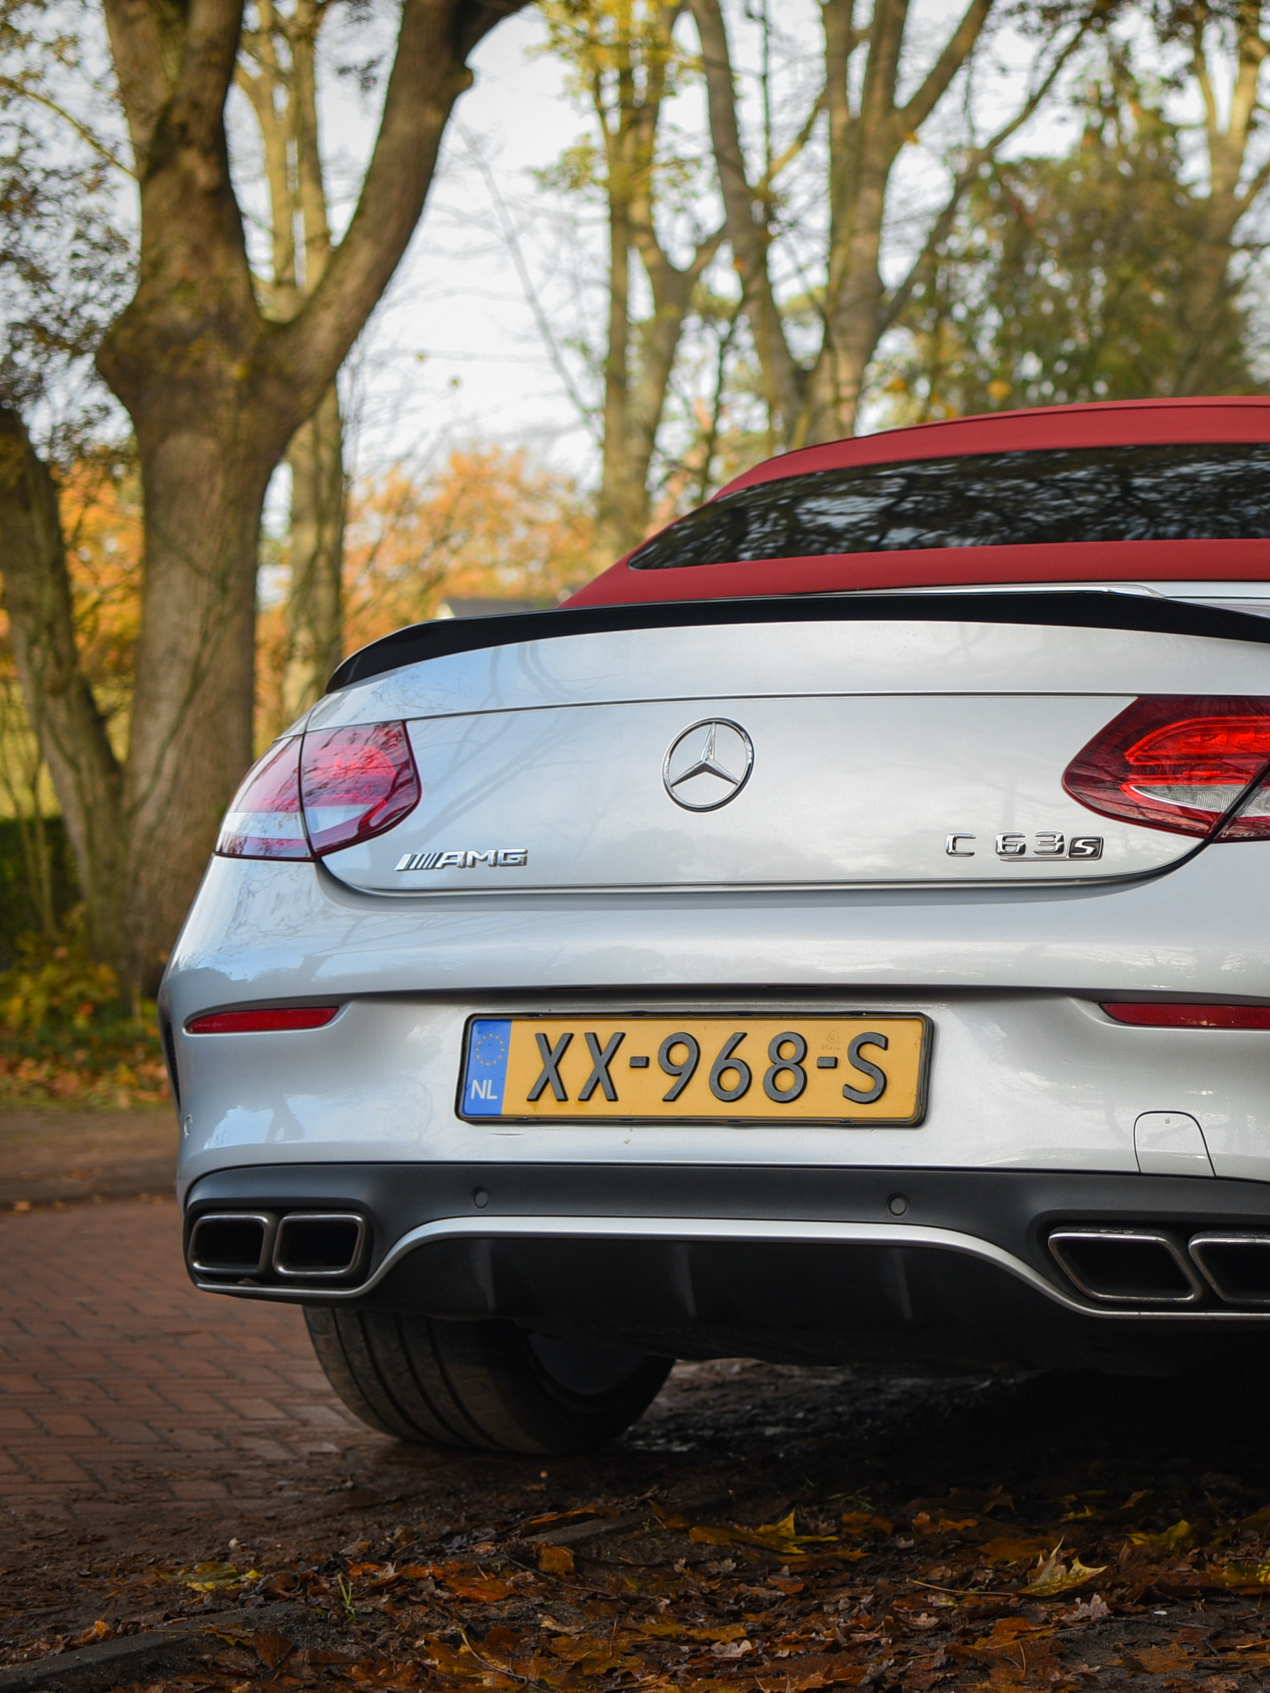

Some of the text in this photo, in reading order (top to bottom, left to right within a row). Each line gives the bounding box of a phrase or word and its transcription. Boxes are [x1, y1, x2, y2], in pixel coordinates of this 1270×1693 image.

[945, 833, 976, 857] C
[526, 1031, 889, 1104] XX-968-S
[470, 1079, 498, 1100] NL
